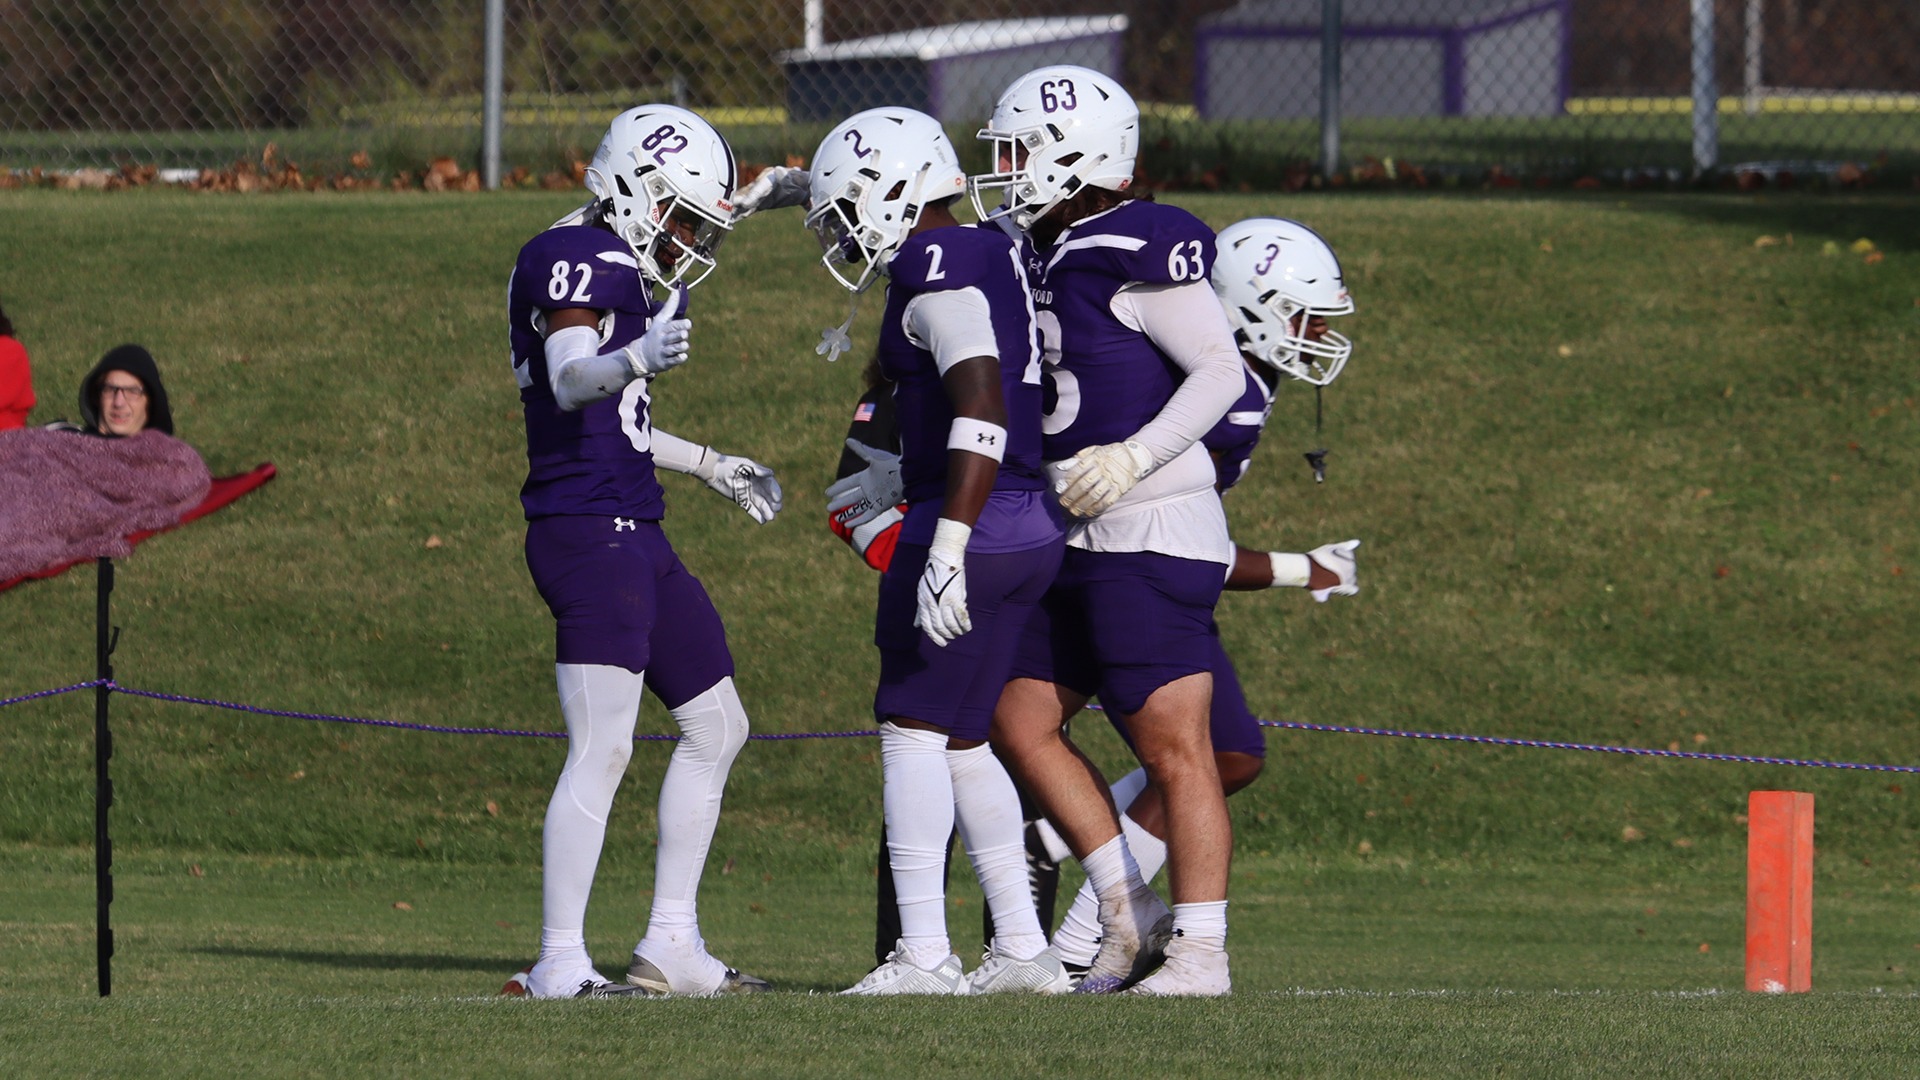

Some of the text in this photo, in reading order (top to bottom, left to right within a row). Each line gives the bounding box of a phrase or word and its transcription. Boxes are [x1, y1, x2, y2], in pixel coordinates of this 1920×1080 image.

[1040, 79, 1077, 113] 63
[642, 124, 688, 165] 82
[843, 129, 872, 159] 2
[925, 244, 945, 282] 2
[1168, 240, 1204, 281] 63
[1255, 243, 1280, 275] 3
[548, 260, 593, 302] 82
[938, 964, 960, 980] NIKE
